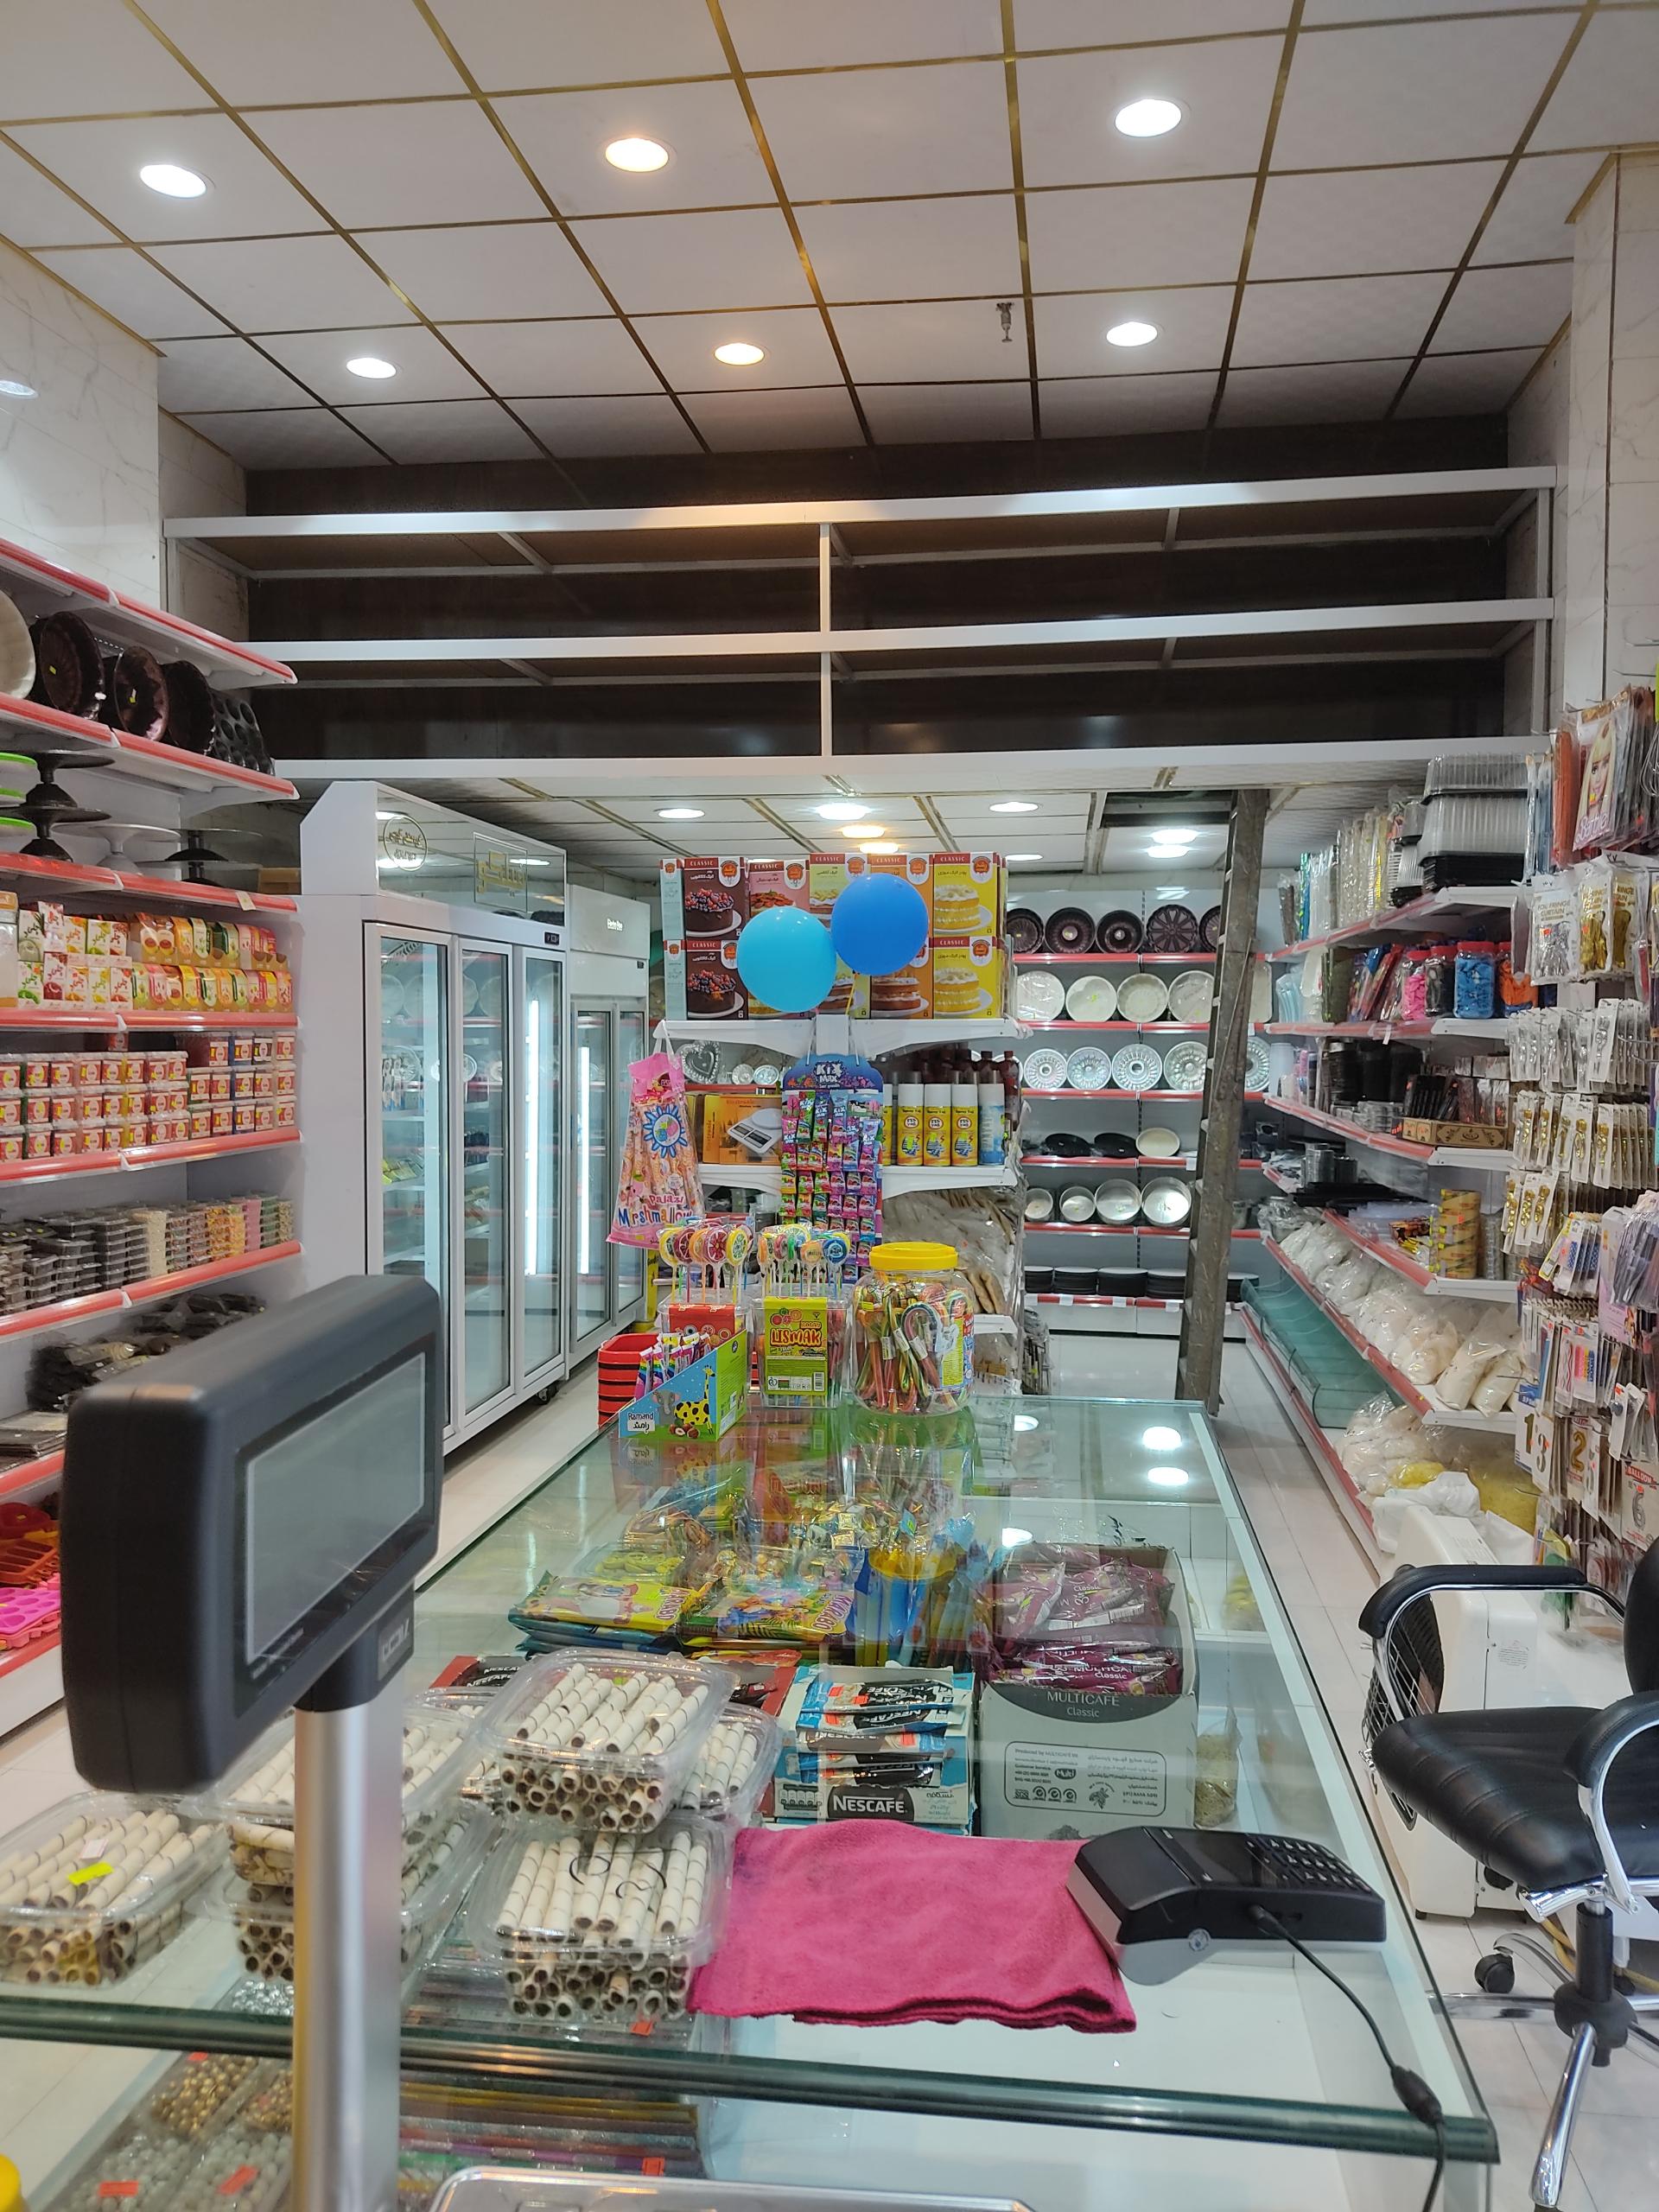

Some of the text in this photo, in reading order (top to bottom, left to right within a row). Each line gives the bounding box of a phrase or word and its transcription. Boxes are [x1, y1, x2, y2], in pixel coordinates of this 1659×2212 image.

[627, 1412, 654, 1421] Ramand
[632, 1421, 650, 1434] رامند
[1628, 1466, 1653, 1484] BALLOON
[1046, 1690, 1121, 1707] MULTICAFE
[1066, 1707, 1100, 1718] Classic
[833, 1794, 906, 1814] NESCAFE
